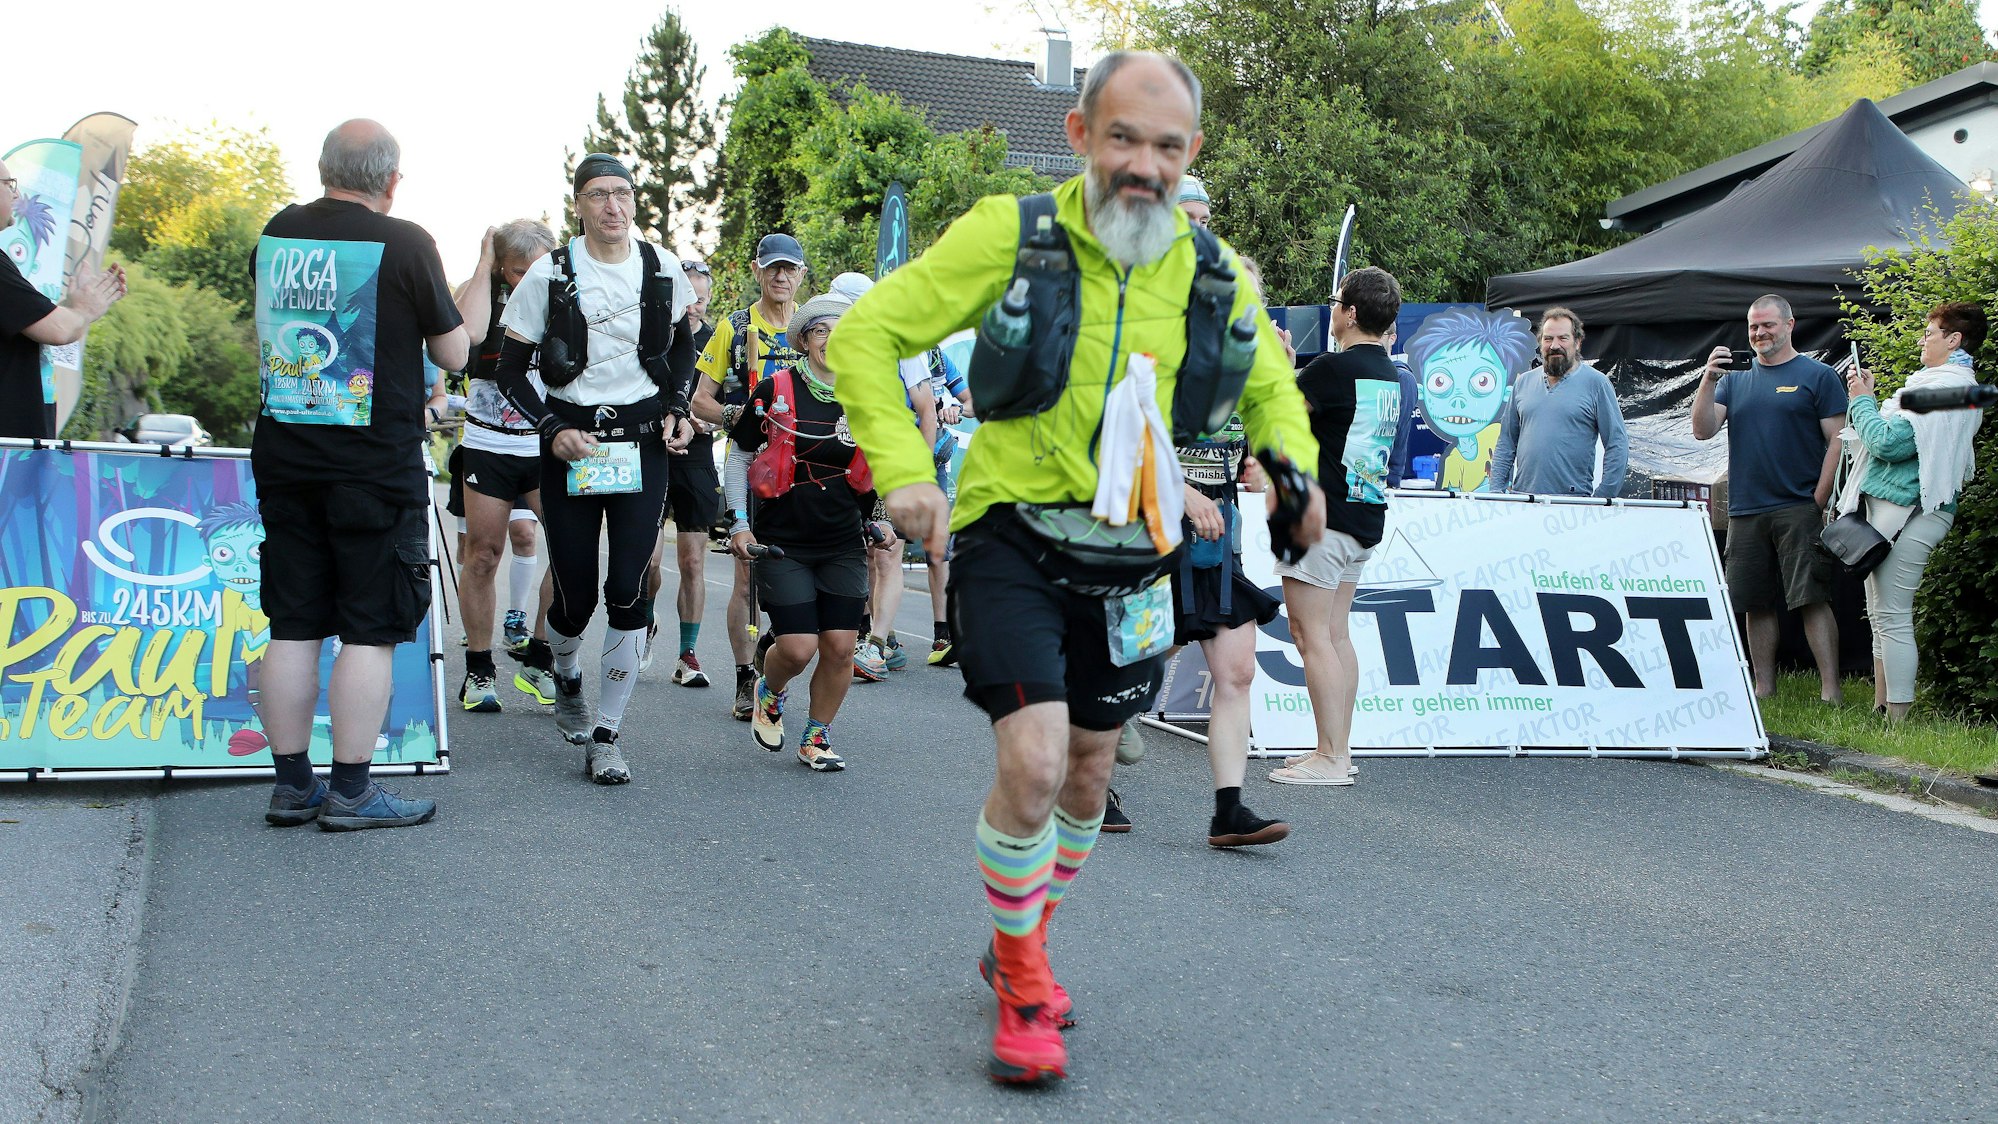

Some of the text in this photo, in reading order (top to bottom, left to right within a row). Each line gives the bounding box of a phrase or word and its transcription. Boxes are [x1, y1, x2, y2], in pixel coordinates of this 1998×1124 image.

[269, 247, 338, 292] ORGA
[269, 355, 304, 377] Paul
[587, 465, 633, 486] 238
[1186, 468, 1227, 480] Finishe
[1531, 568, 1707, 592] laufen & wandern
[81, 587, 224, 628] BIS ZU 245KM
[0, 586, 244, 702] Paul
[1255, 586, 1714, 690] START
[8, 668, 208, 742] Team
[1264, 691, 1554, 717] Höheter gehen immer
